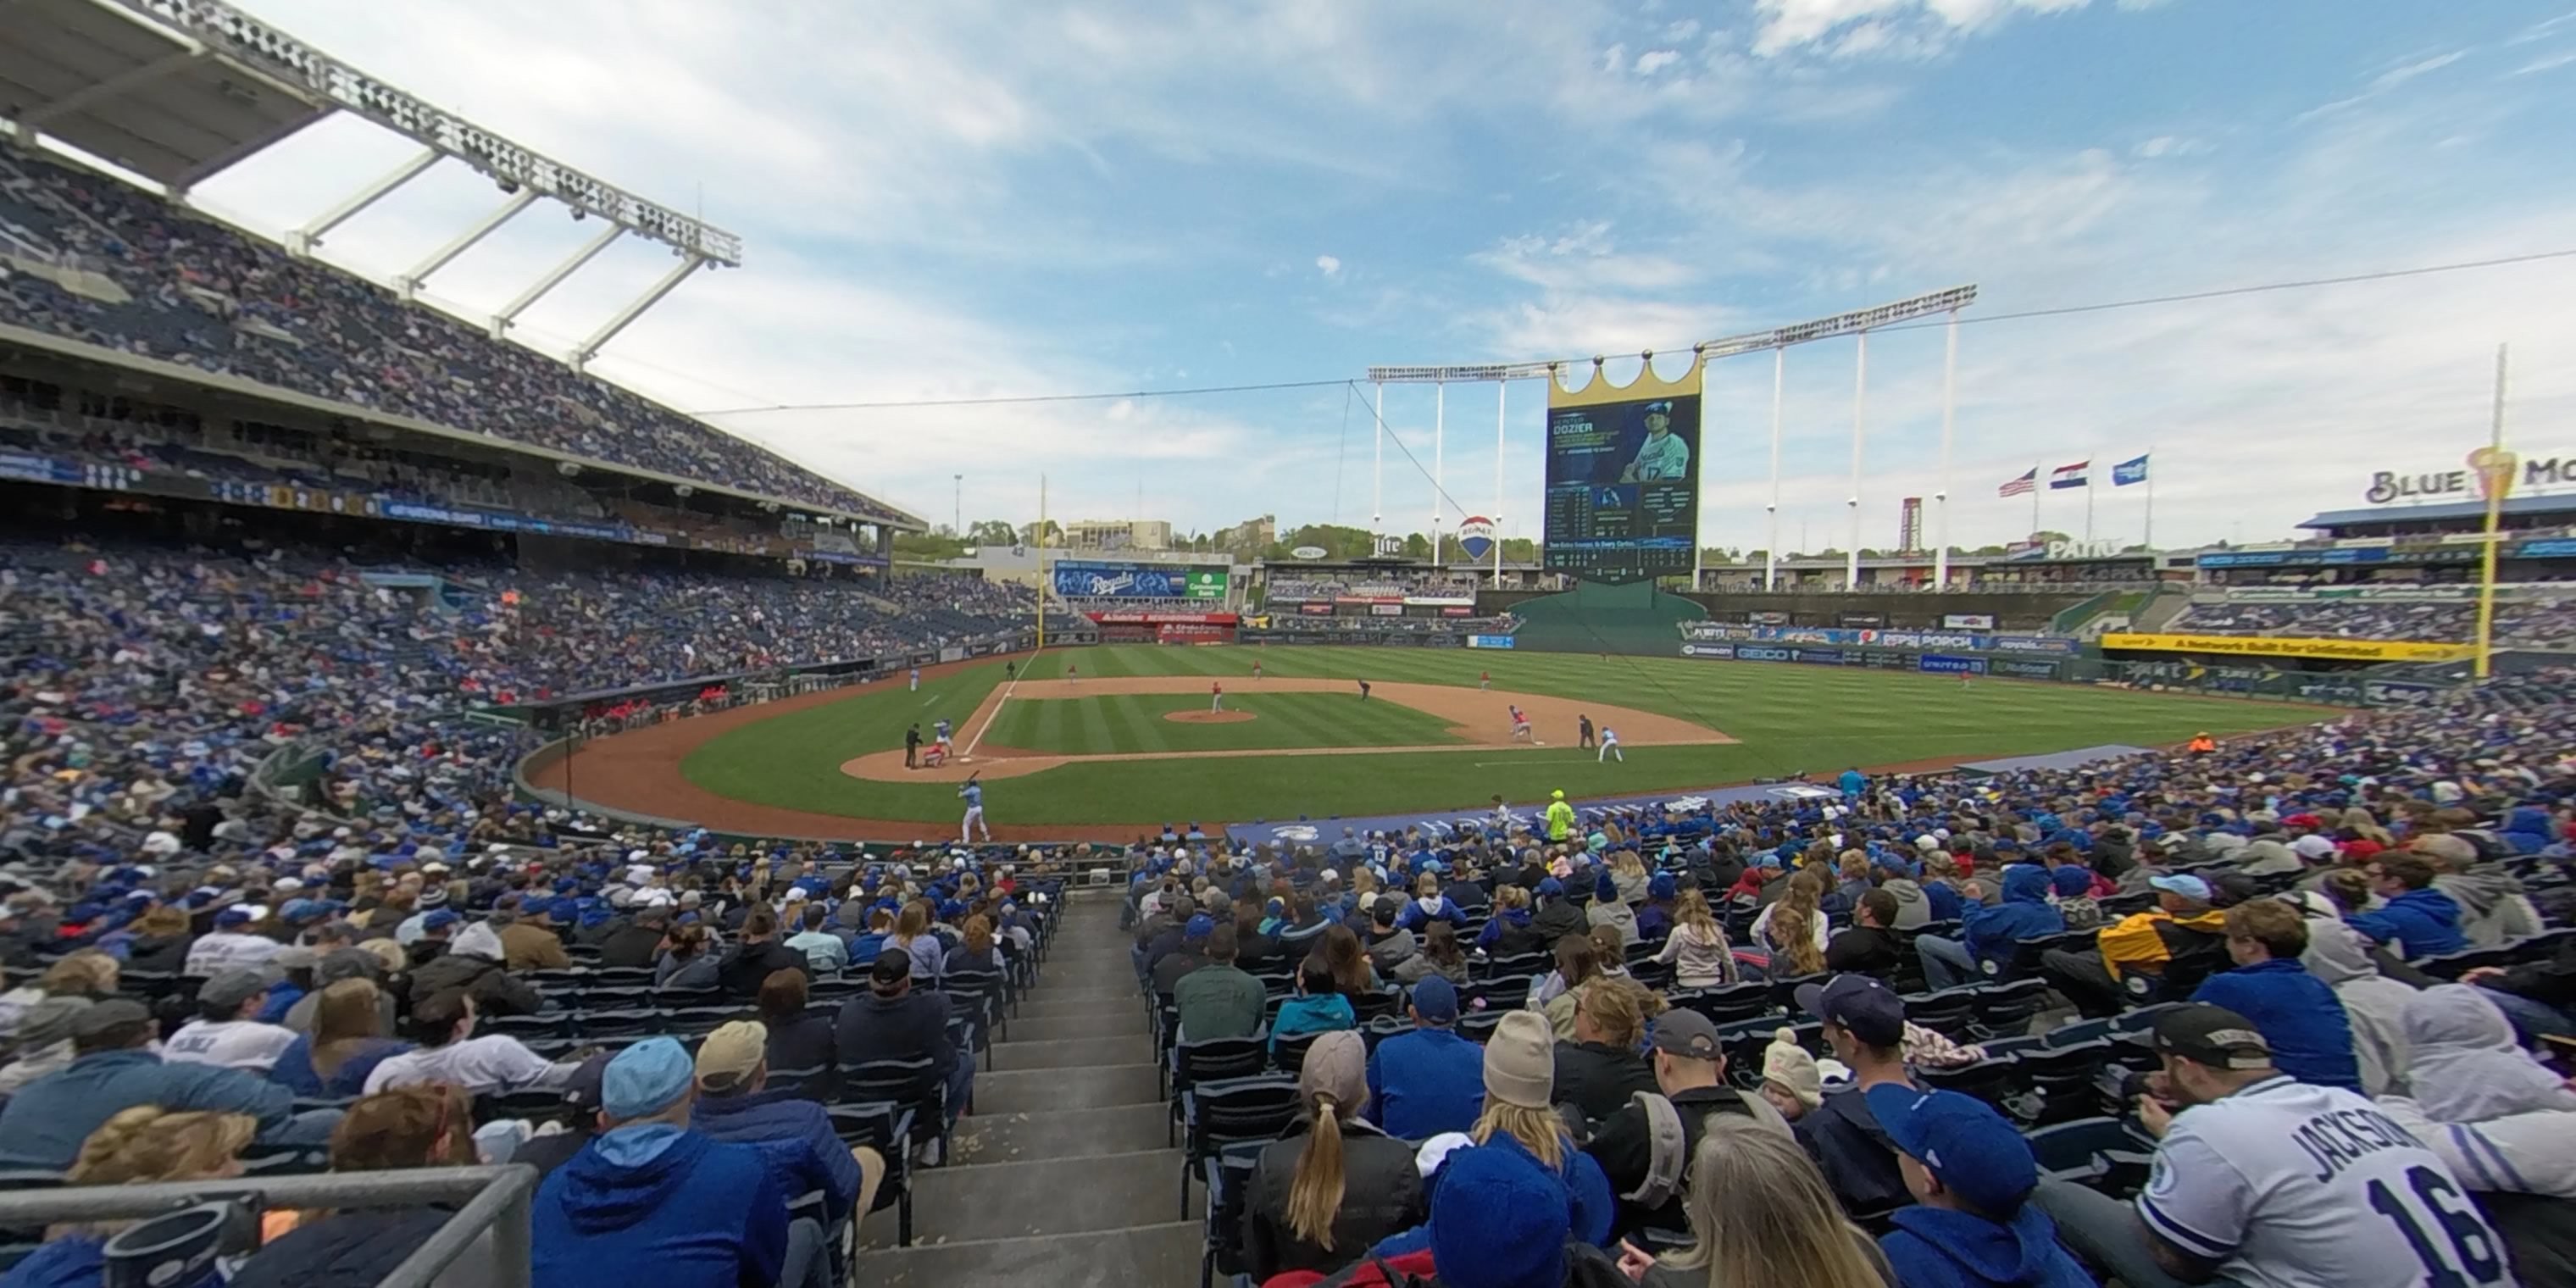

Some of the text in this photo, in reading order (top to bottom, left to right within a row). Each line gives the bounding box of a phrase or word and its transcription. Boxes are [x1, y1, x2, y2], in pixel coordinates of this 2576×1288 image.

[1553, 423, 1593, 435] DOZIER
[2366, 471, 2465, 503] BLUE
[1091, 571, 1134, 595] Royals
[1884, 634, 1919, 648] PEPSI
[1738, 650, 1788, 660] GEICO
[2367, 1164, 2503, 1288] 16
